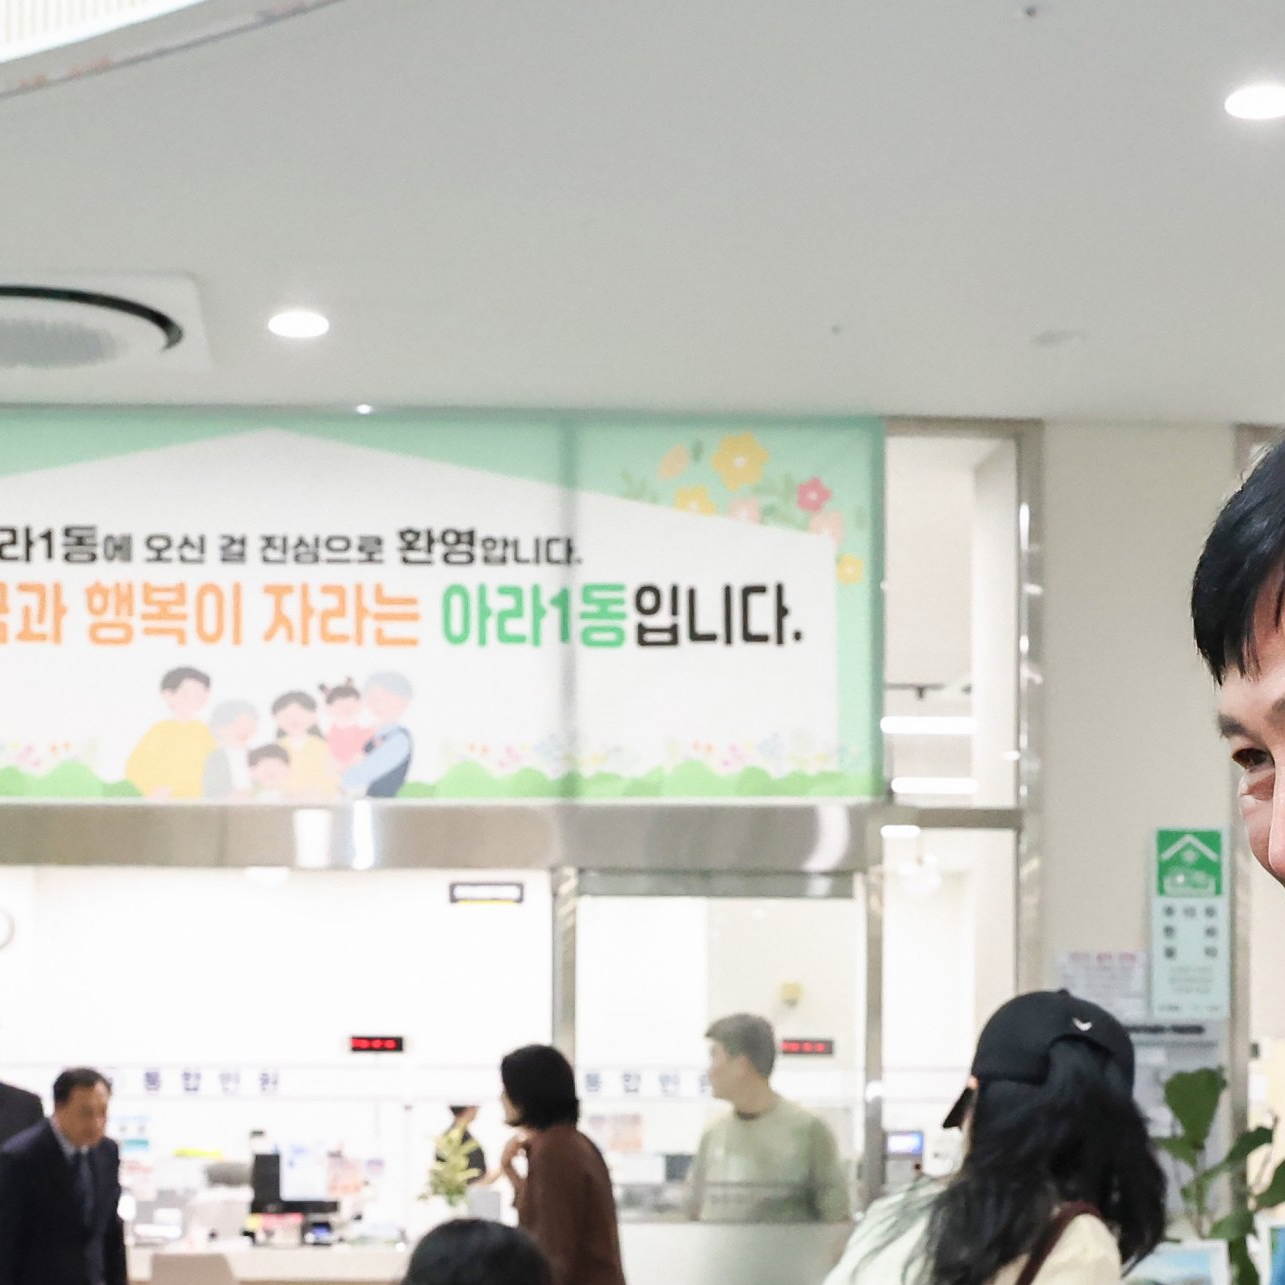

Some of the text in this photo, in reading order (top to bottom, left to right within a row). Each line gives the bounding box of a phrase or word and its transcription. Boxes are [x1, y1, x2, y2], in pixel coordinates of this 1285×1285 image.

[143, 533, 206, 565] 오신
[220, 533, 247, 564] 걸
[259, 534, 384, 565] 진심으로
[397, 527, 582, 567] 환영합니다.
[84, 580, 243, 647] 행복이
[262, 581, 421, 647] 자라는
[440, 581, 803, 648] 아라1동입니다.
